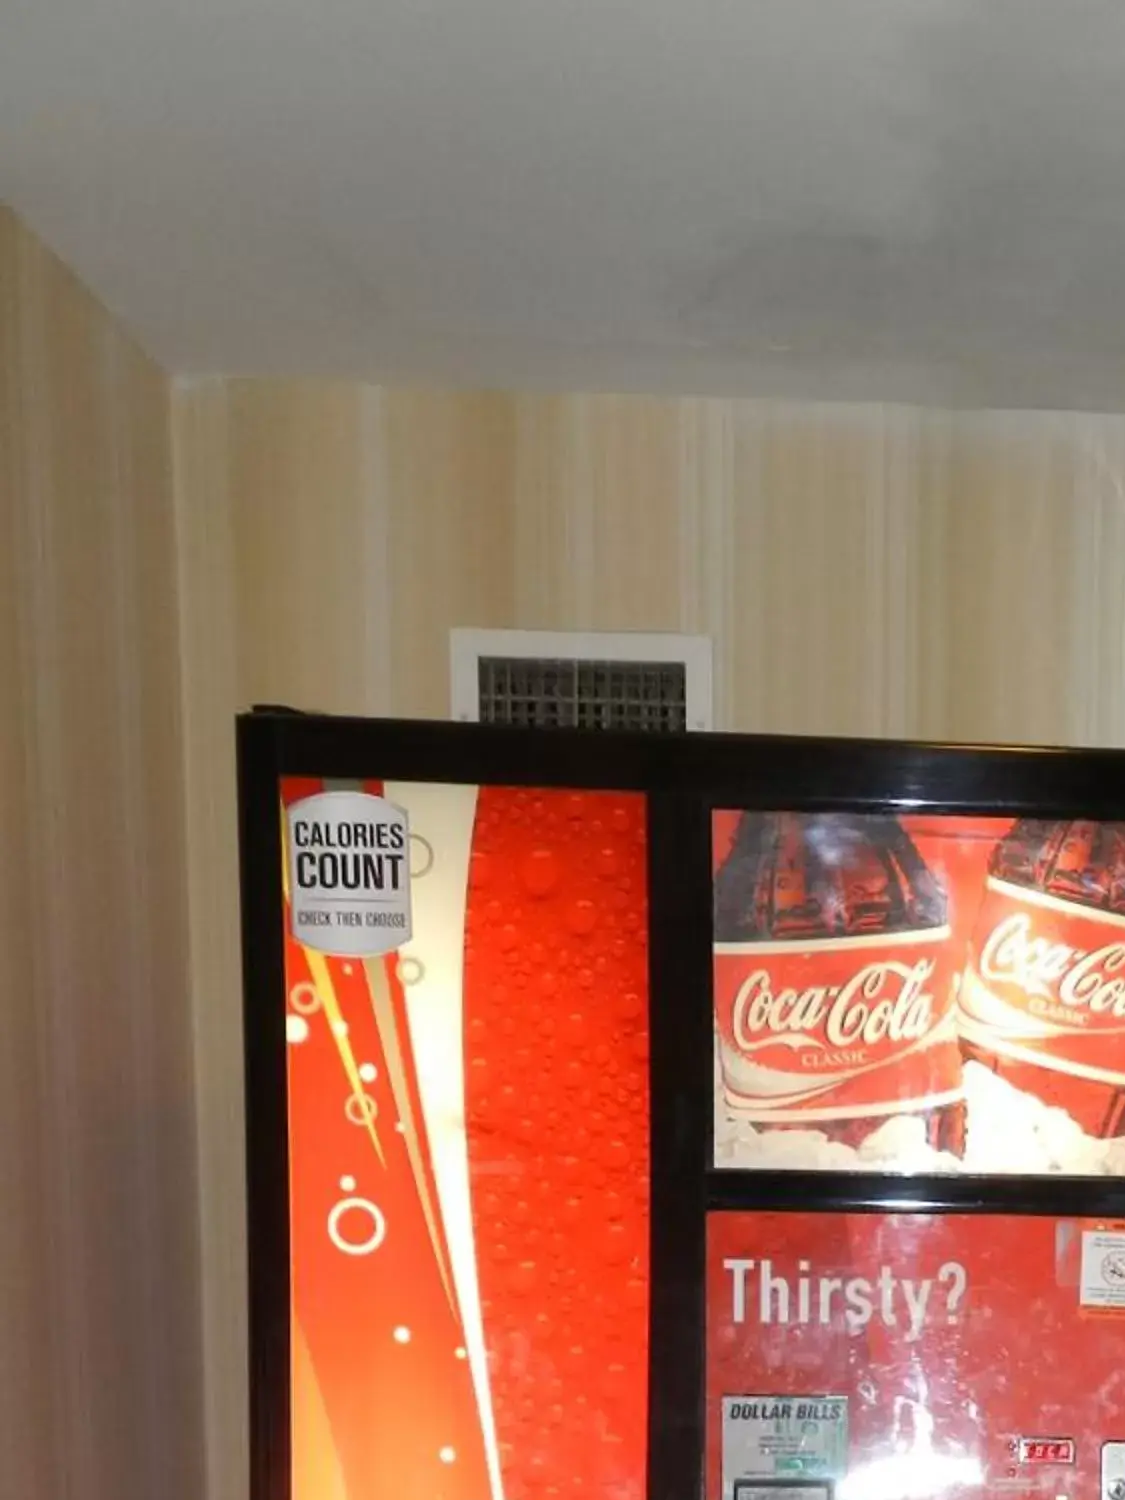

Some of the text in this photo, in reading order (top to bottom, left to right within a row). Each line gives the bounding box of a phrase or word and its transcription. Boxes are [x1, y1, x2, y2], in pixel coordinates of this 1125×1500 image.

[294, 821, 404, 849] CALORIES
[296, 852, 404, 890] COUNT
[298, 911, 406, 928] CHECK THEN CHOOSE
[732, 956, 937, 1050] Coca-Cola
[801, 1050, 869, 1068] CLASSIC
[723, 1258, 967, 1342] Thirsty?
[729, 1403, 842, 1420] DOLLAR BILLS
